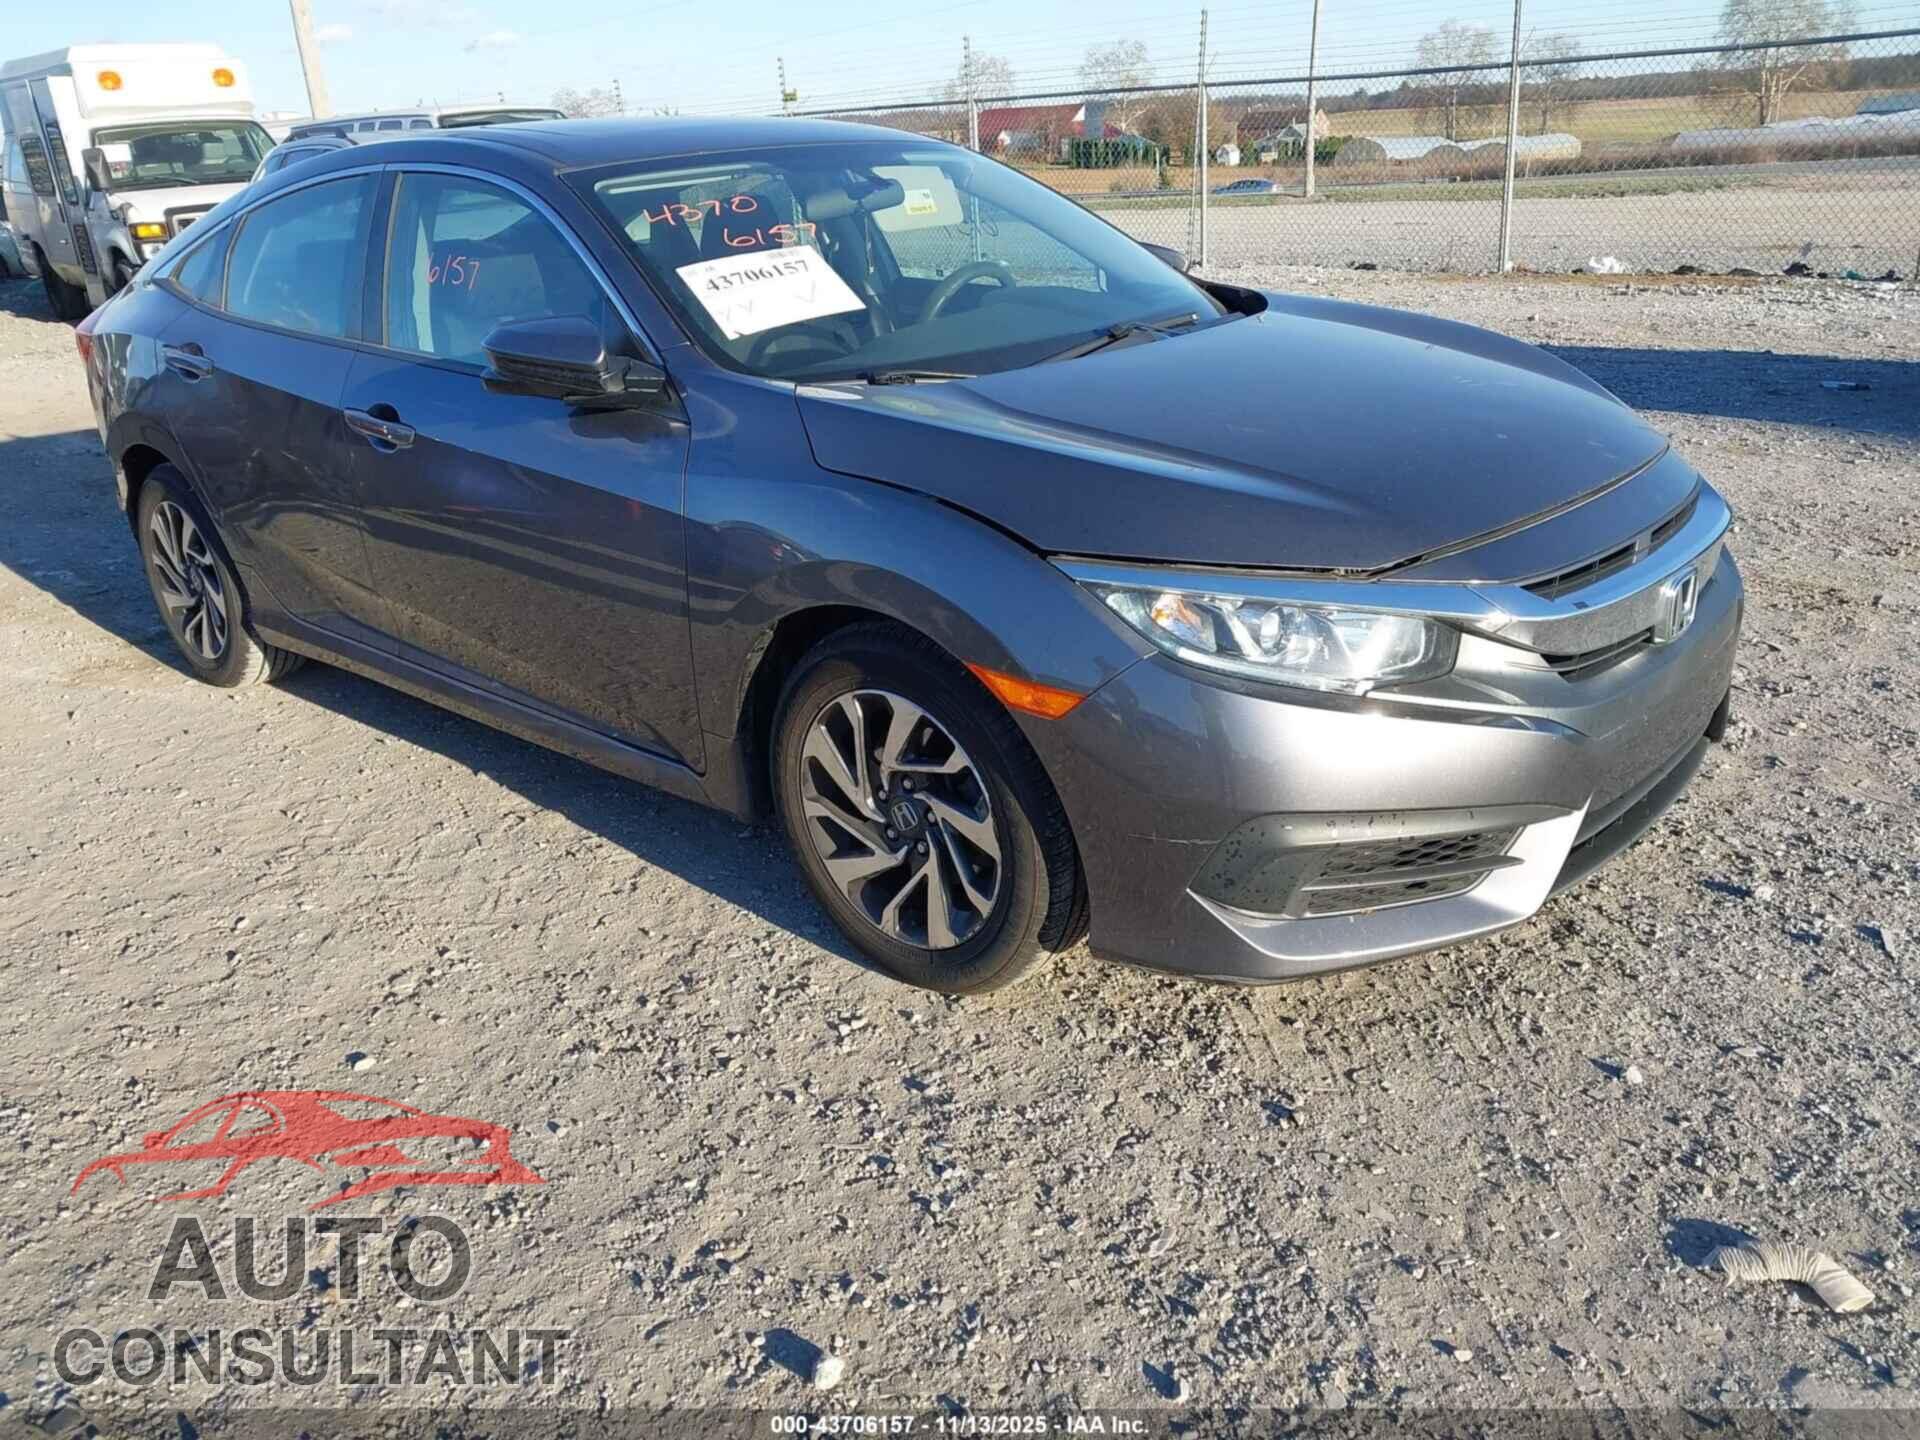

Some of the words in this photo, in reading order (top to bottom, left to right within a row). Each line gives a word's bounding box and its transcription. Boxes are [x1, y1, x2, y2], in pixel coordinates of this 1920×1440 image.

[643, 195, 758, 226] 4370
[723, 223, 817, 247] 6157
[425, 253, 480, 290] 6157
[705, 259, 809, 292] 43706157
